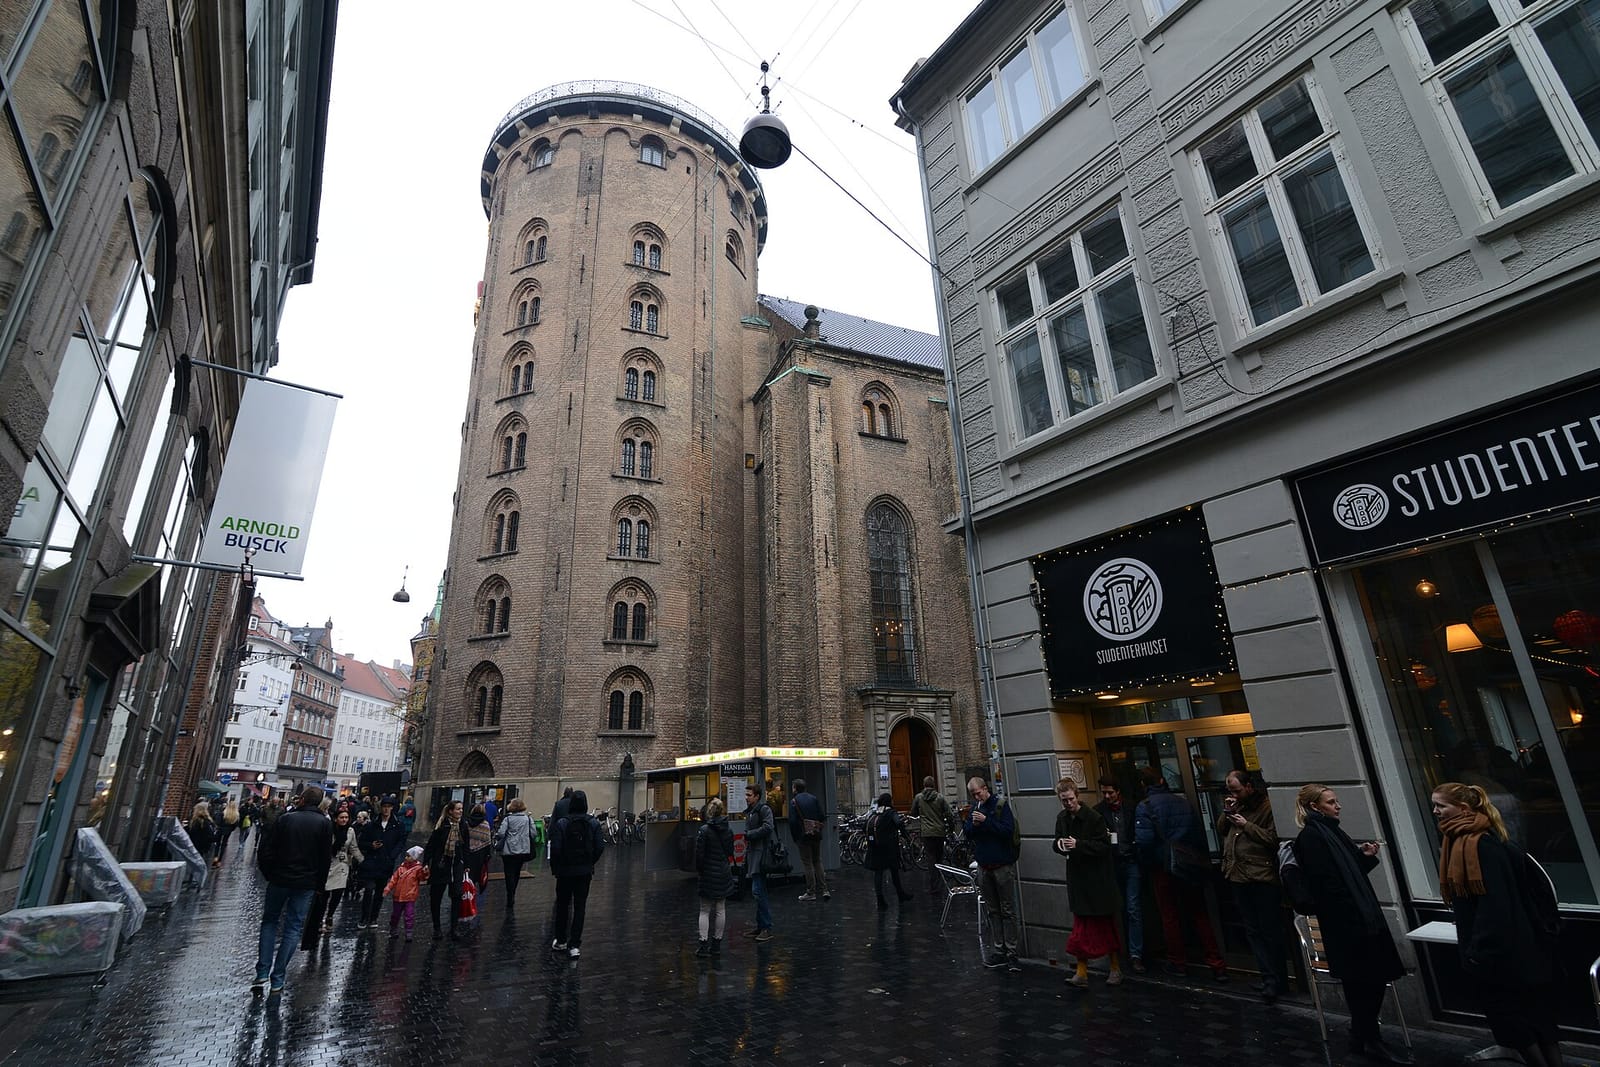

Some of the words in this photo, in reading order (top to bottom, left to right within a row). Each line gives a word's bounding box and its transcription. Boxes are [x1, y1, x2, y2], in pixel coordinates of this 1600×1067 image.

[220, 516, 300, 539] ARNOLD
[225, 533, 288, 554] BUSCK
[1096, 638, 1168, 665] STUDENTERHUSET
